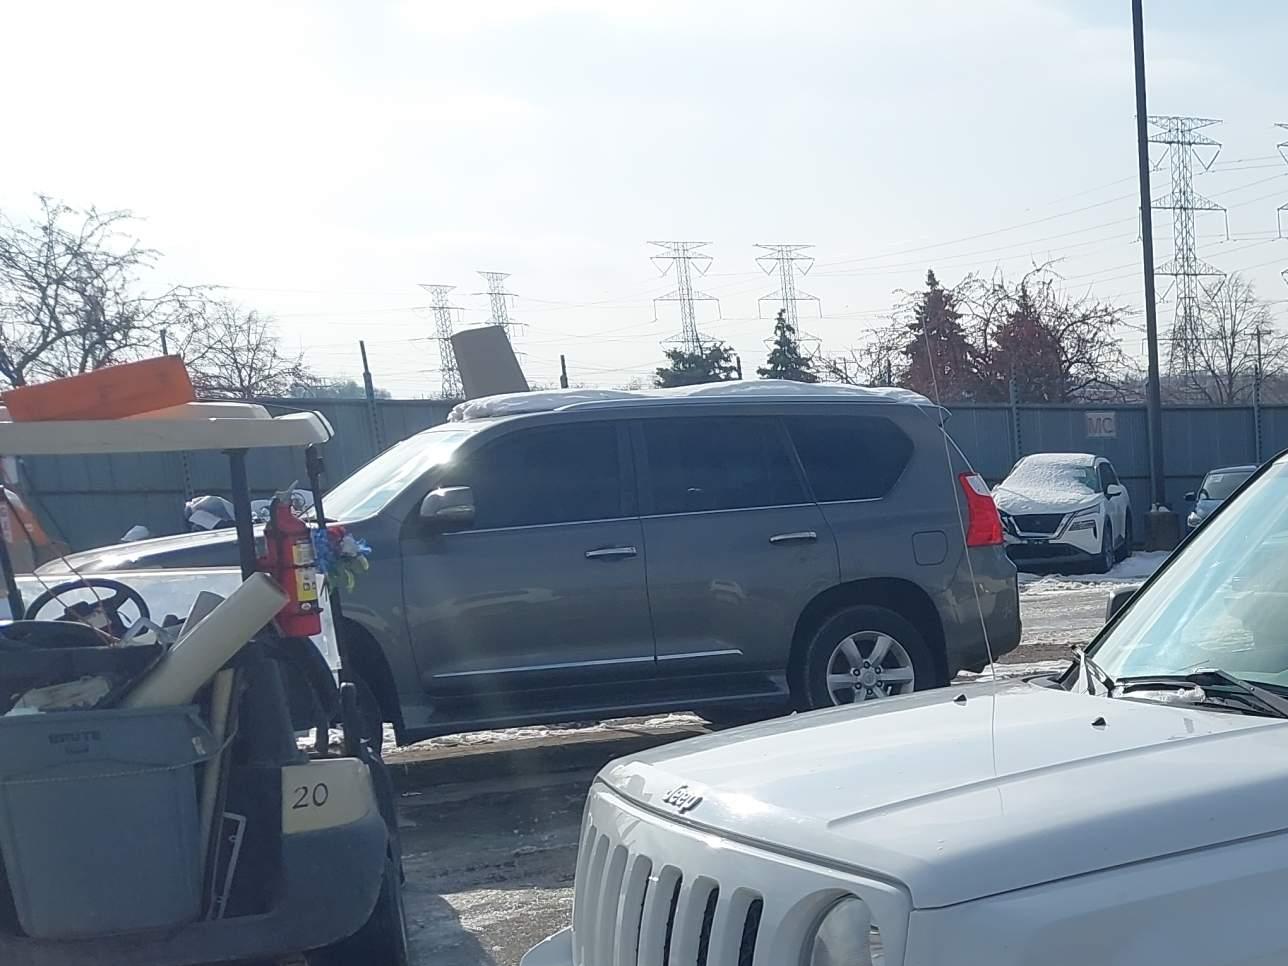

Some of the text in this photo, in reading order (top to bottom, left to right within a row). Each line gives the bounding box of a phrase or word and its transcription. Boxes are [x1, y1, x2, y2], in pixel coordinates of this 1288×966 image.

[1088, 417, 1113, 434] MC
[292, 782, 329, 810] 20
[662, 783, 704, 815] Jeep
